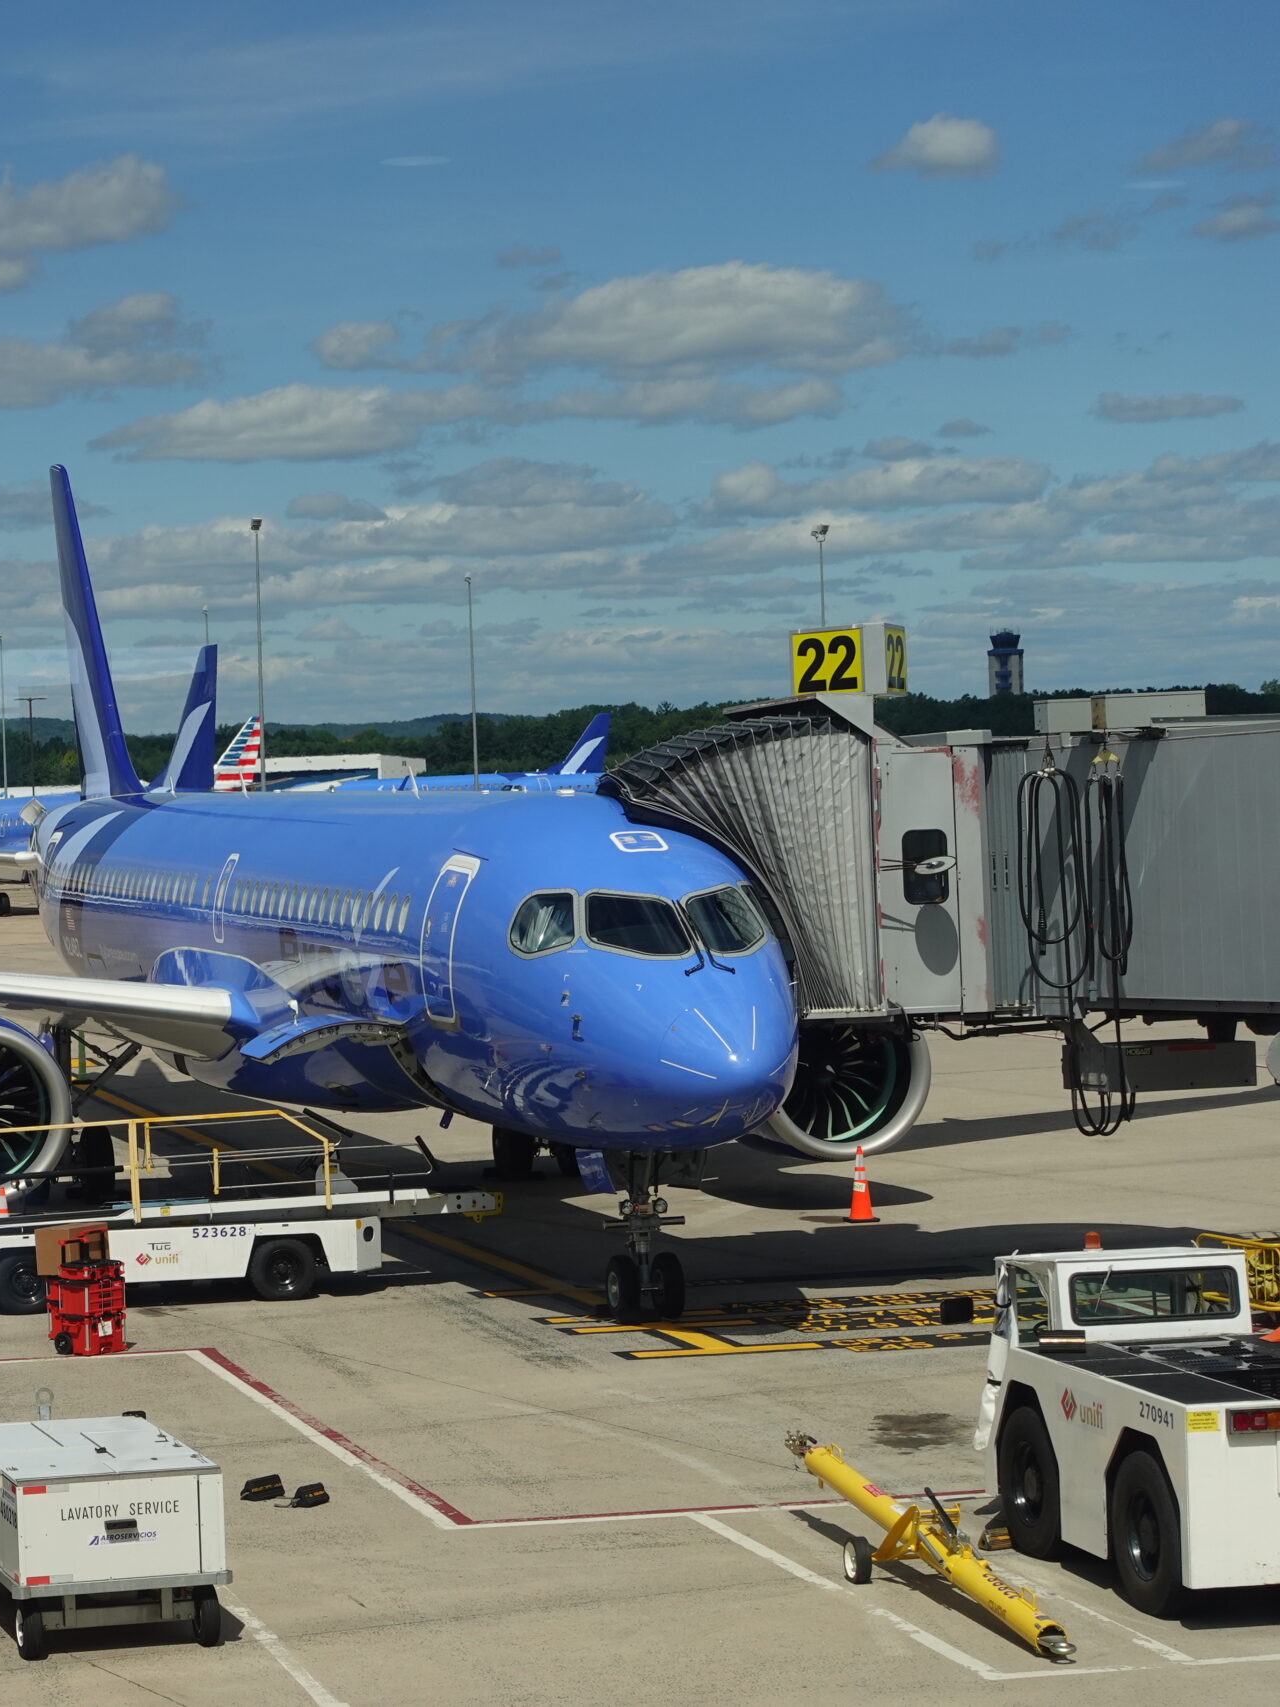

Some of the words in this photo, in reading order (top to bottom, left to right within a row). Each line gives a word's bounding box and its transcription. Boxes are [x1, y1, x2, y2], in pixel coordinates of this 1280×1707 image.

[797, 635, 858, 693] 22
[886, 634, 905, 690] 22
[192, 1226, 246, 1238] 523628
[155, 1253, 179, 1265] unifi
[832, 1336, 913, 1346] CRJ
[1079, 1401, 1104, 1430] unifi
[1139, 1400, 1174, 1430] 270941
[60, 1504, 119, 1521] LAVATORY
[129, 1500, 180, 1516] SERVICE
[100, 1531, 157, 1541] AEROSERVICIOS
